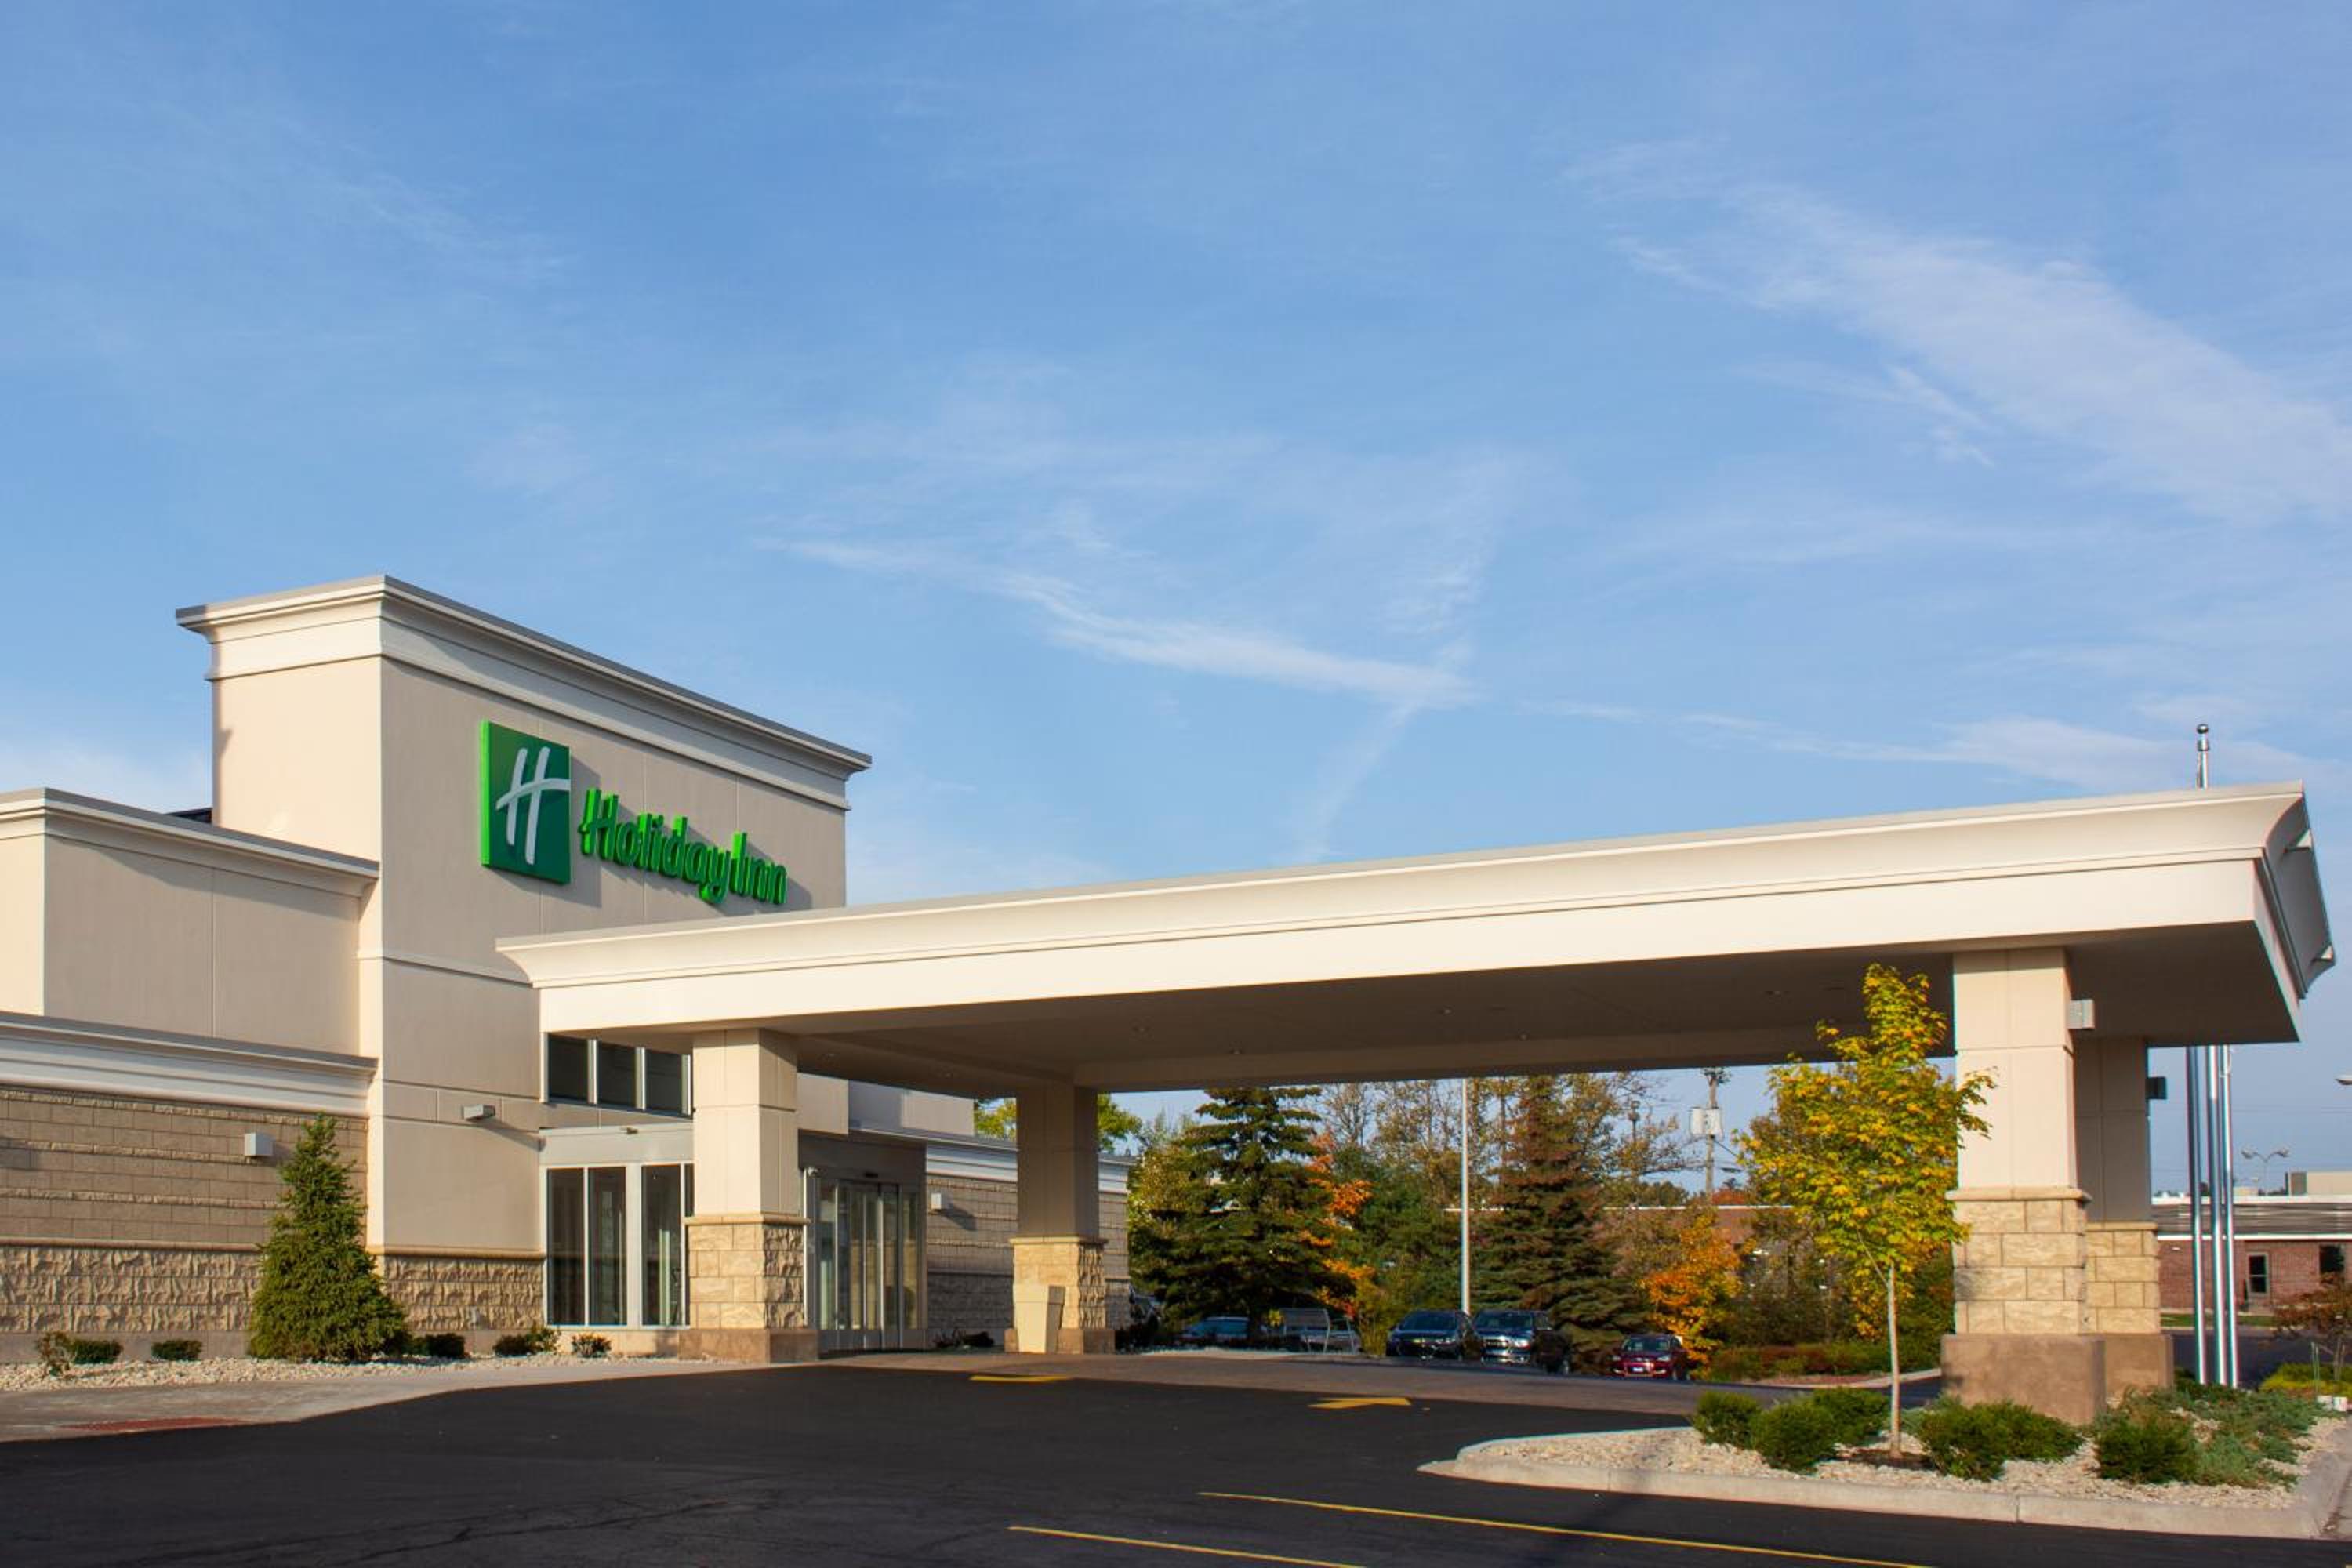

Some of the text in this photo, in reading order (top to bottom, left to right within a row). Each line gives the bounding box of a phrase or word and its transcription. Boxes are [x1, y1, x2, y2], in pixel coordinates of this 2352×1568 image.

[496, 746, 571, 865] H
[579, 787, 787, 904] Holiday Inn
